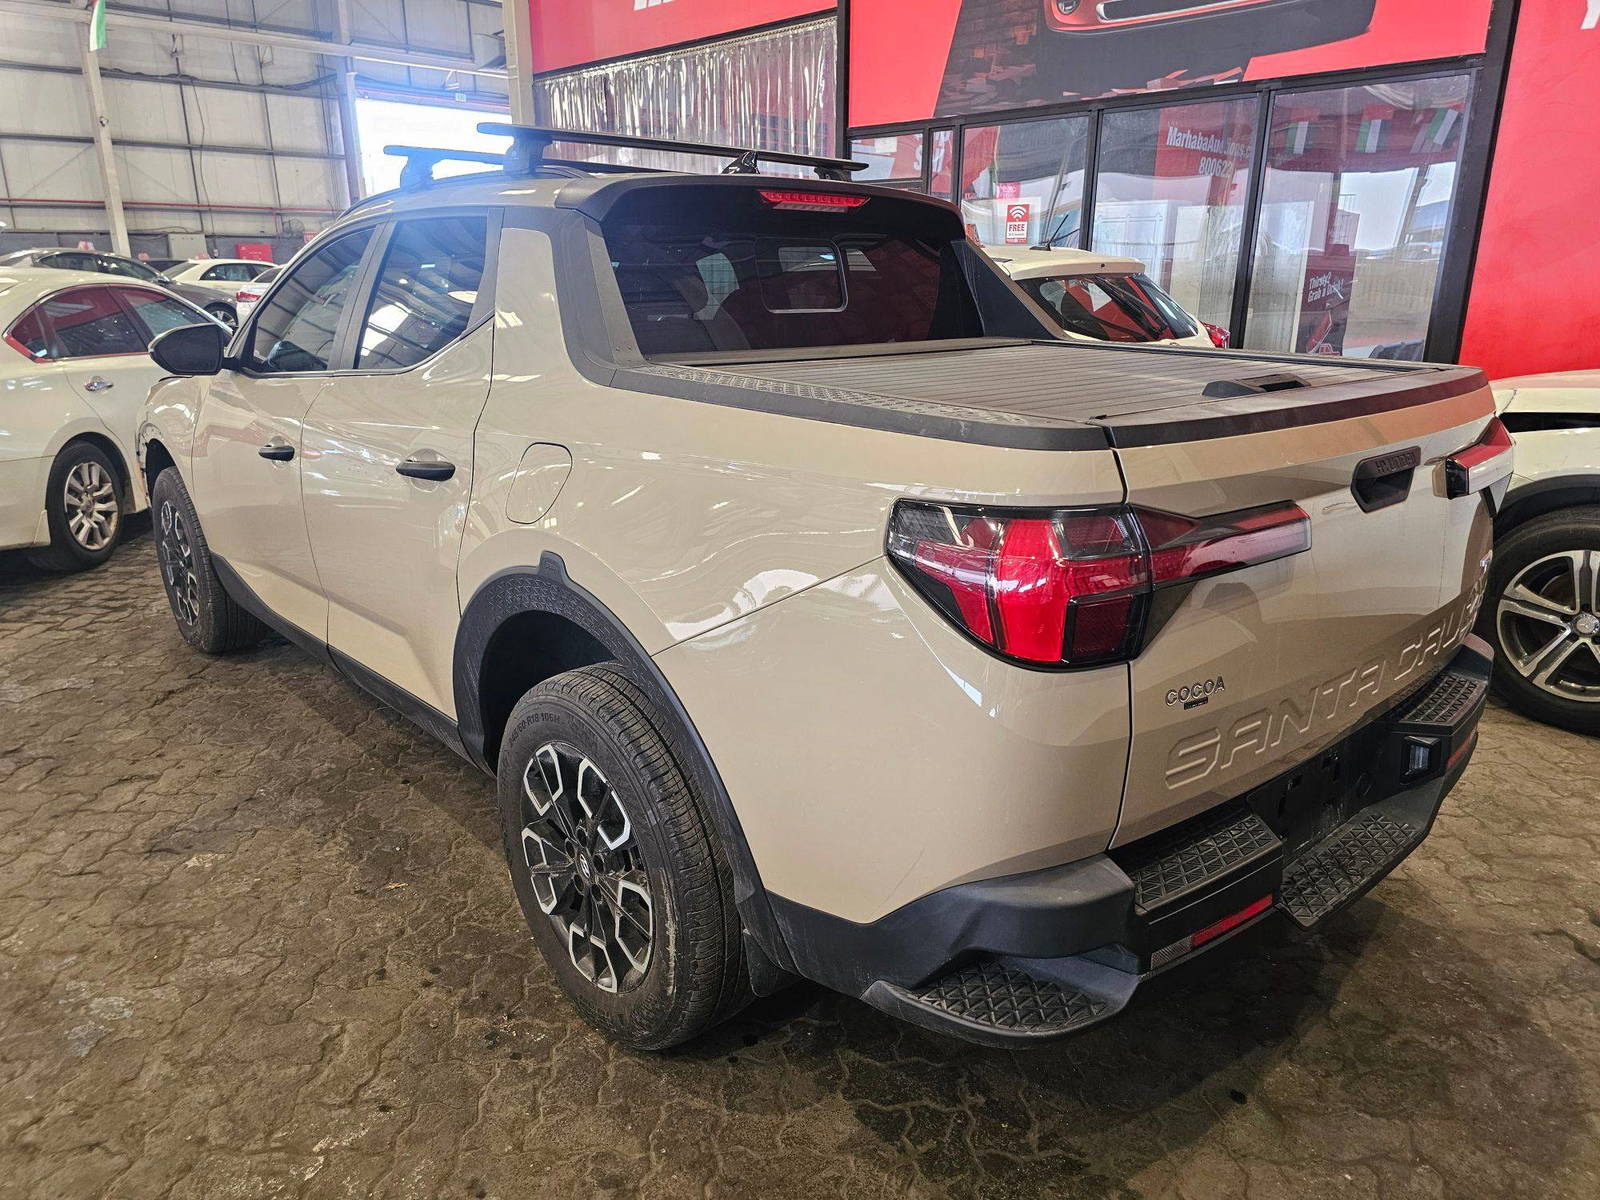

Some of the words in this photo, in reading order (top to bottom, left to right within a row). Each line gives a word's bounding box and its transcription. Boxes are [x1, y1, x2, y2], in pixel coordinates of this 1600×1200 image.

[1008, 223, 1026, 232] FREE
[1164, 675, 1227, 707] COCOA
[1165, 660, 1387, 790] SANTA
